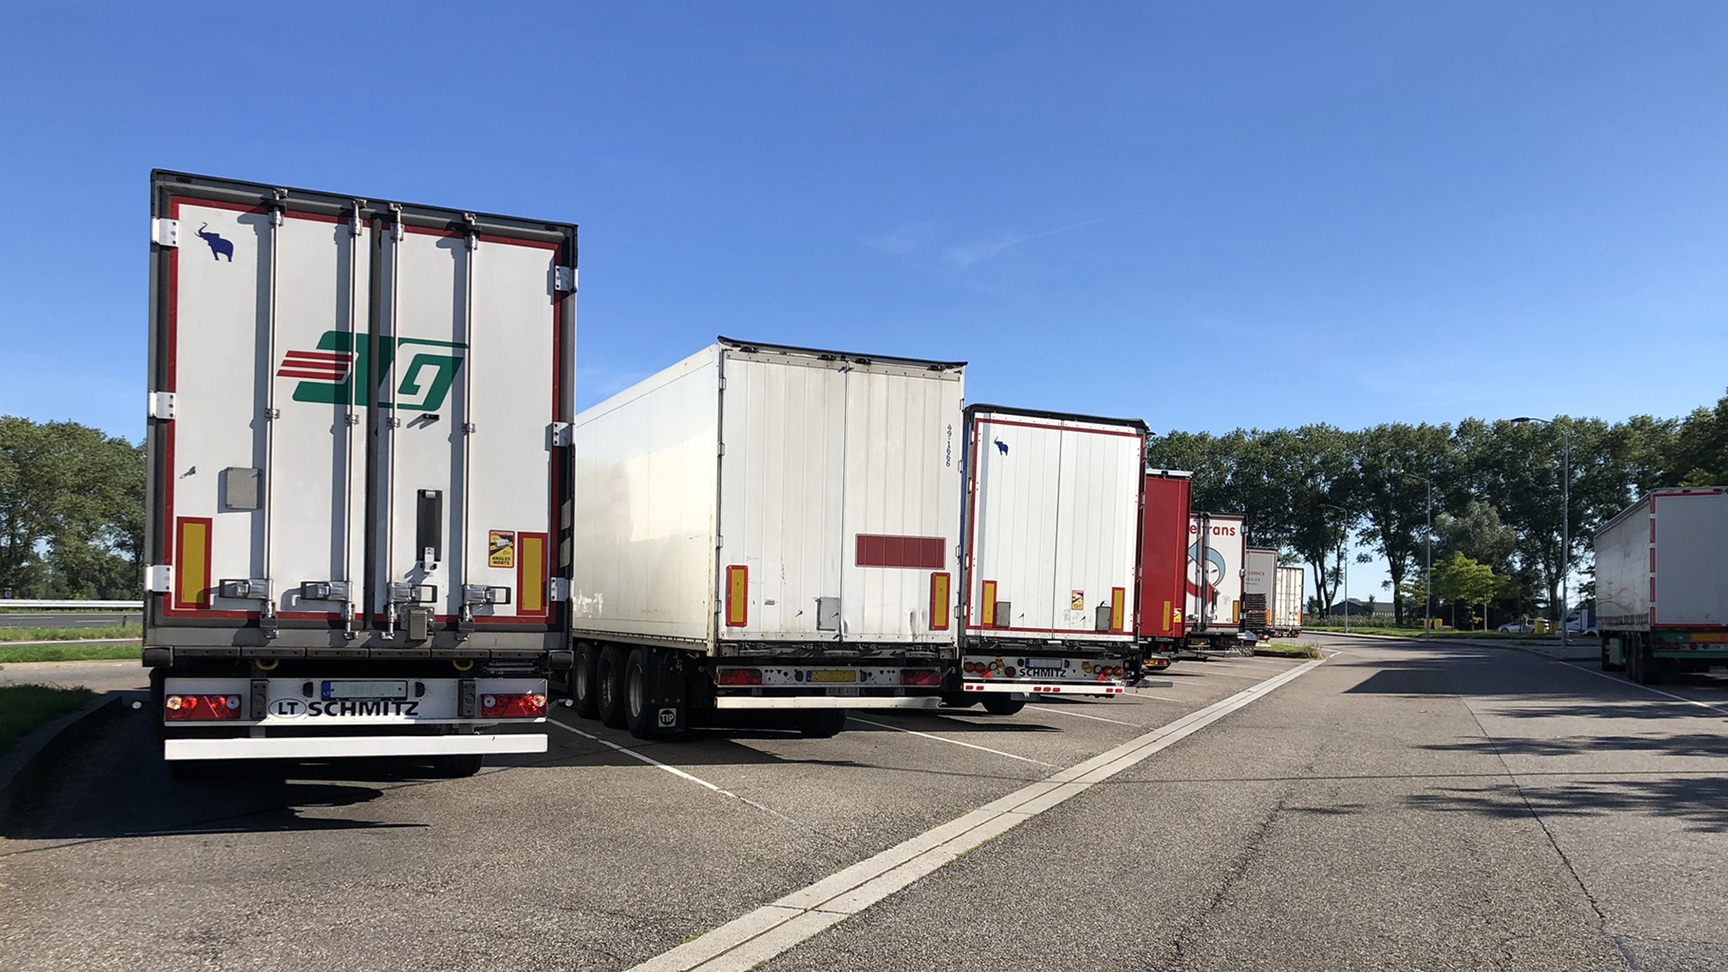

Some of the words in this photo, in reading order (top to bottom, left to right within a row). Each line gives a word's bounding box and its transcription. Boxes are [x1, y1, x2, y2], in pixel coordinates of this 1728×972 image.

[1020, 668, 1067, 678] SCHMITZ
[278, 702, 299, 715] LT
[308, 701, 419, 716] SCHMITZ
[660, 713, 674, 723] TIP
